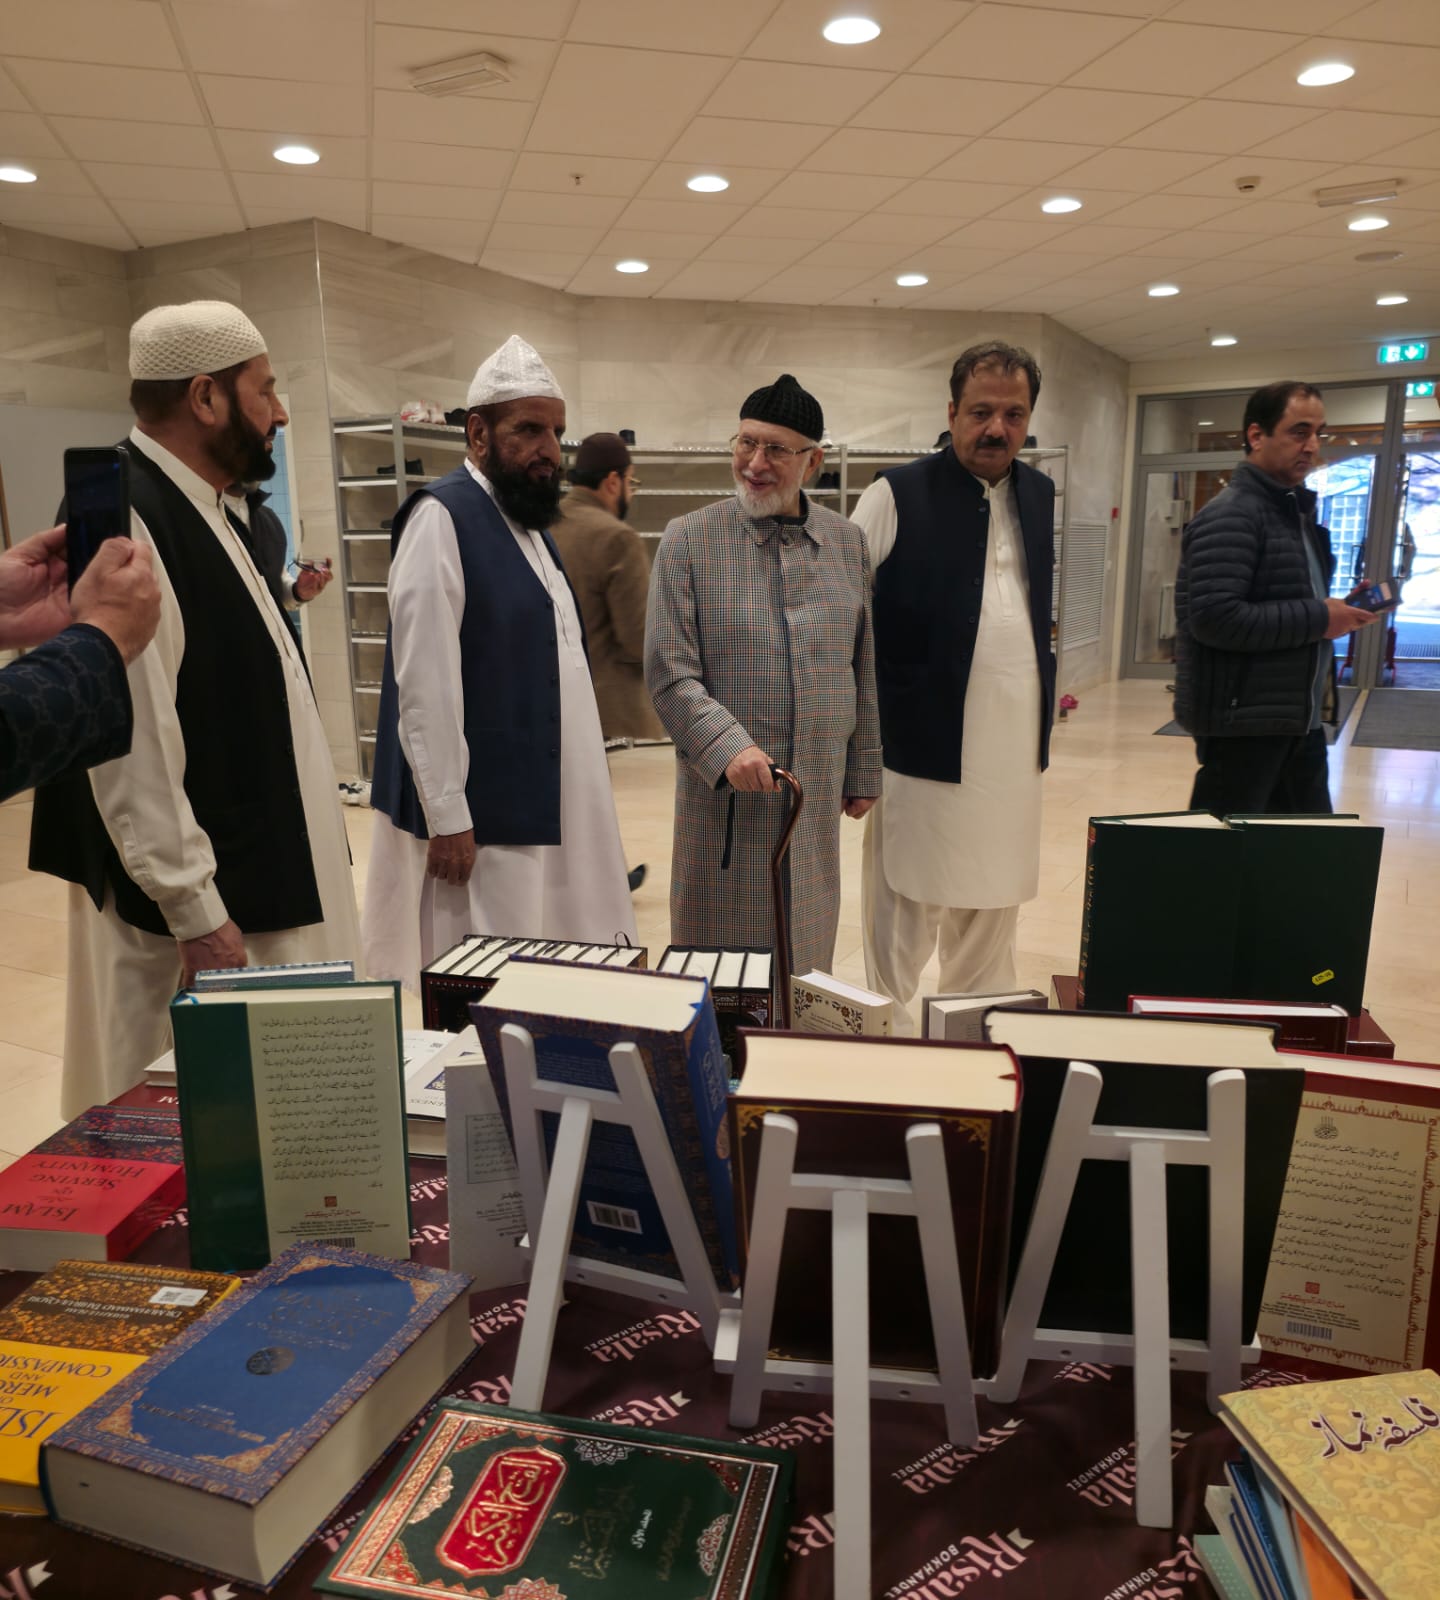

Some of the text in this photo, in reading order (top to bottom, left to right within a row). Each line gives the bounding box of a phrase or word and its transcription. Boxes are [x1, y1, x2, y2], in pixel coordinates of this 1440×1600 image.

[29, 1173, 121, 1191] SERVING
[31, 1161, 145, 1179] HUMANITY
[2, 1202, 80, 1222] ISLAM
[469, 1303, 509, 1324] BOKHA
[583, 1319, 652, 1351] BOKHANDEL
[591, 1310, 701, 1363] Risala
[9, 1371, 46, 1382] AND
[611, 1395, 680, 1427] Ris
[1309, 1410, 1375, 1457] نماز
[891, 1442, 953, 1480] OKHANDEL
[1066, 1447, 1128, 1491] BOKHANDEL
[883, 1543, 959, 1600] BOKHANDEL
